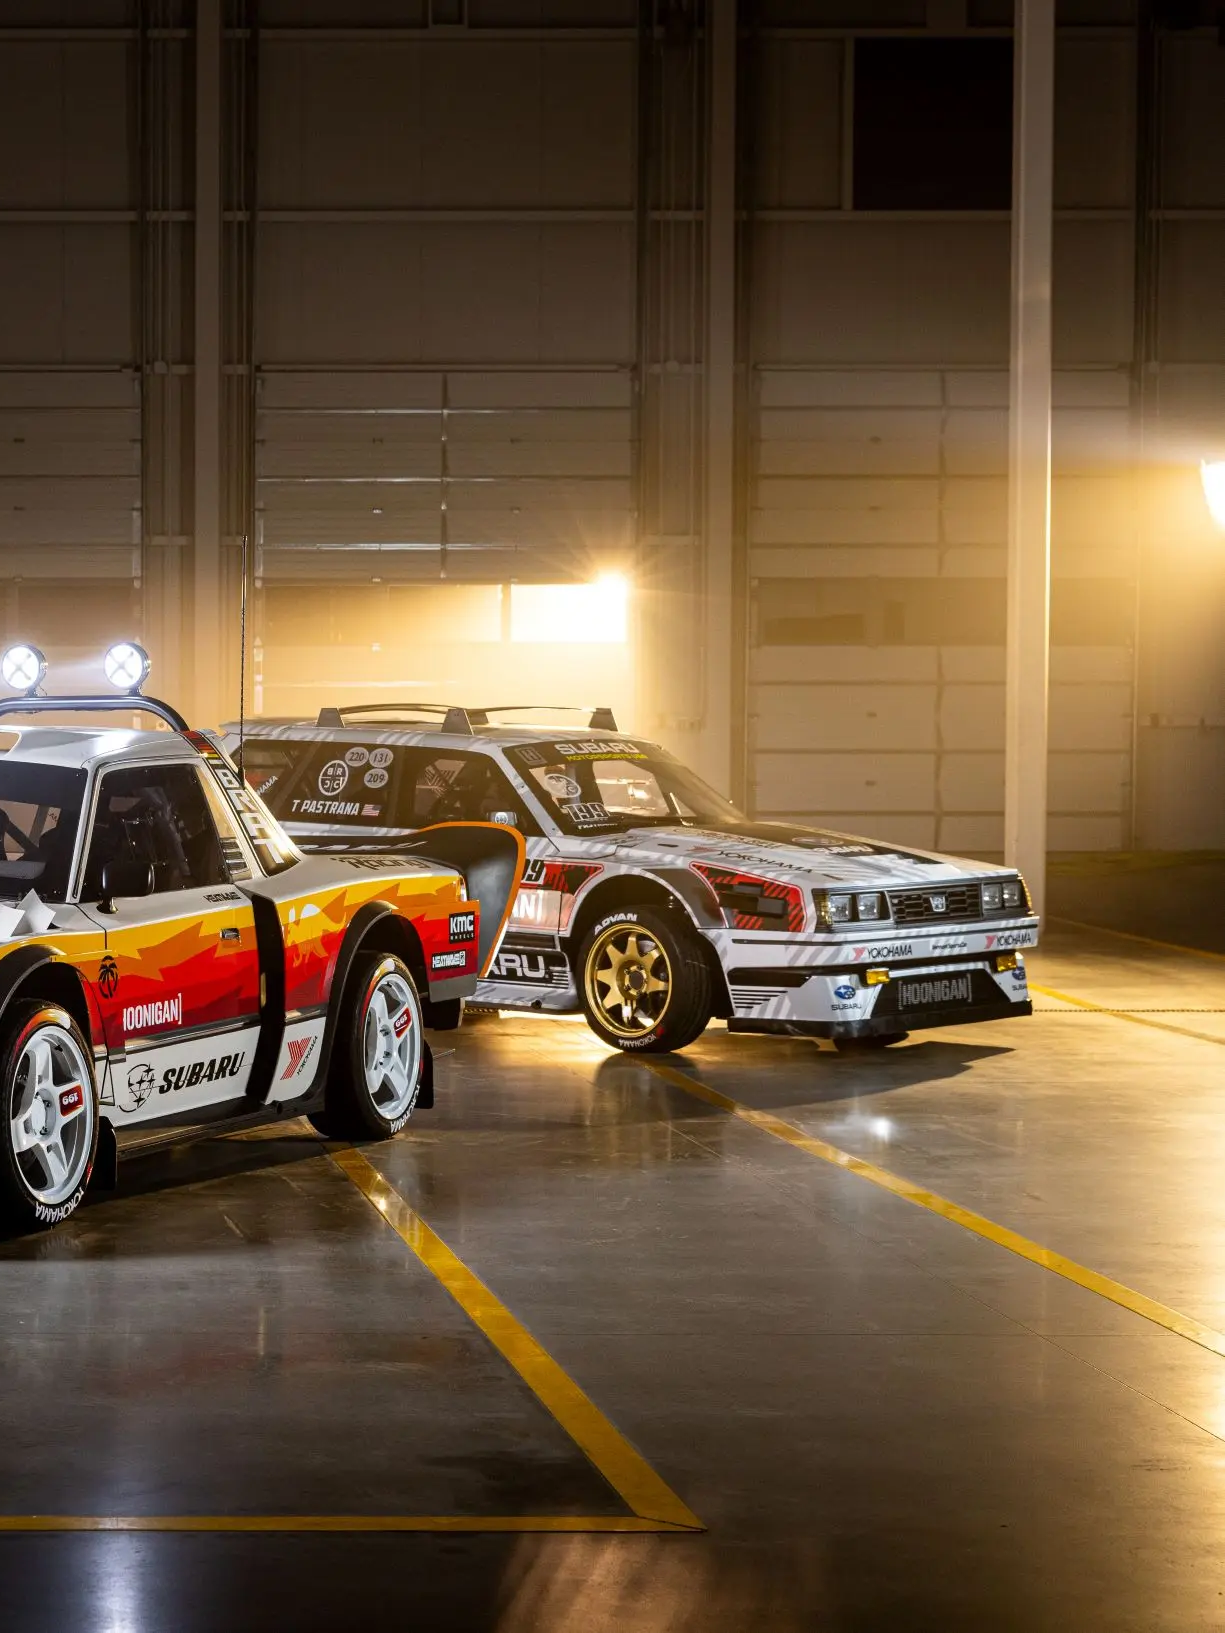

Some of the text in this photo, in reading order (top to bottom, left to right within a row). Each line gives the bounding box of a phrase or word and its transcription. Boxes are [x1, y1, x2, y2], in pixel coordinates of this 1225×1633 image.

[350, 751, 365, 761] 220
[554, 743, 639, 755] SUBARU
[367, 773, 385, 783] 209
[292, 800, 360, 816] T PASTRANA
[718, 850, 812, 874] YOKOHAMA
[450, 914, 474, 933] KMC
[594, 912, 638, 935] ADVAN
[996, 933, 1032, 946] YOKOHAMA
[867, 944, 913, 959] YOKOHAMA
[898, 973, 972, 1010] [HOONIGAN]
[618, 1033, 656, 1047] YOKOHAMA
[158, 1051, 245, 1095] SUBARU
[34, 1187, 84, 1223] YOKOHAMA
